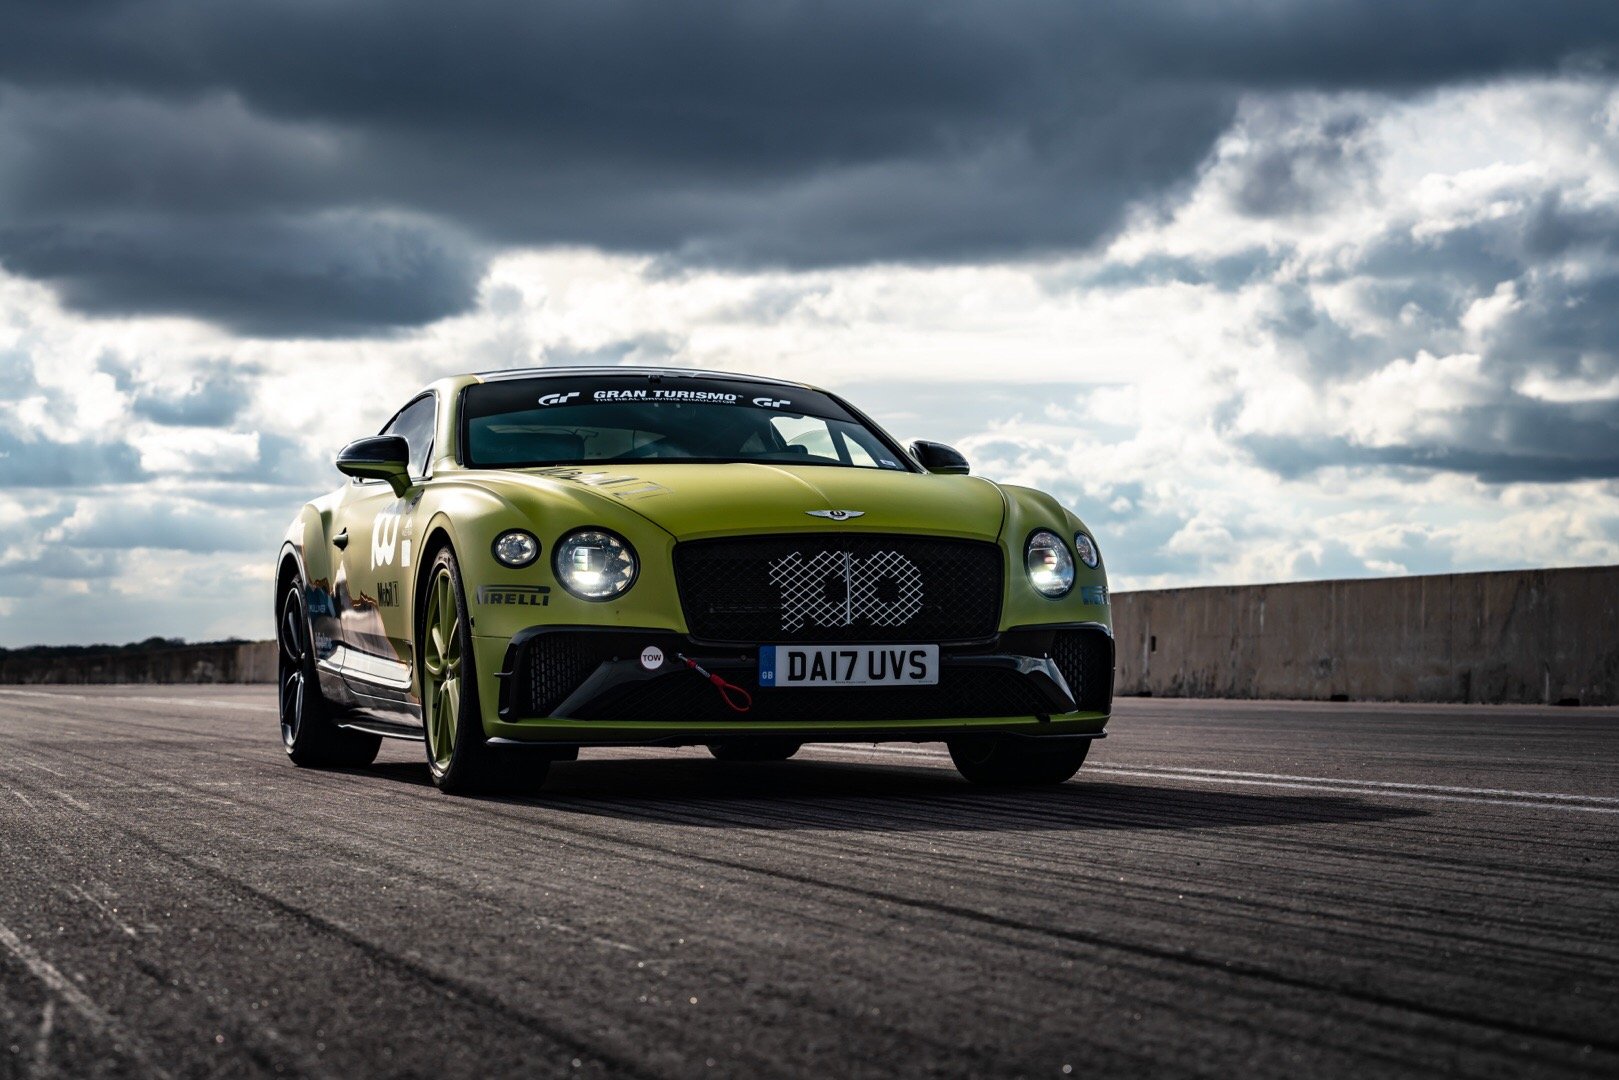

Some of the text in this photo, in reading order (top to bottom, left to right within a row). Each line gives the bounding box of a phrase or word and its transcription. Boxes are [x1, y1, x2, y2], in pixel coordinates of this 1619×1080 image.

[593, 390, 737, 401] GRAN TURISMO
[769, 551, 924, 633] 100
[642, 654, 662, 662] TOW
[788, 650, 927, 681] DA17 UVS
[762, 671, 774, 680] GB
